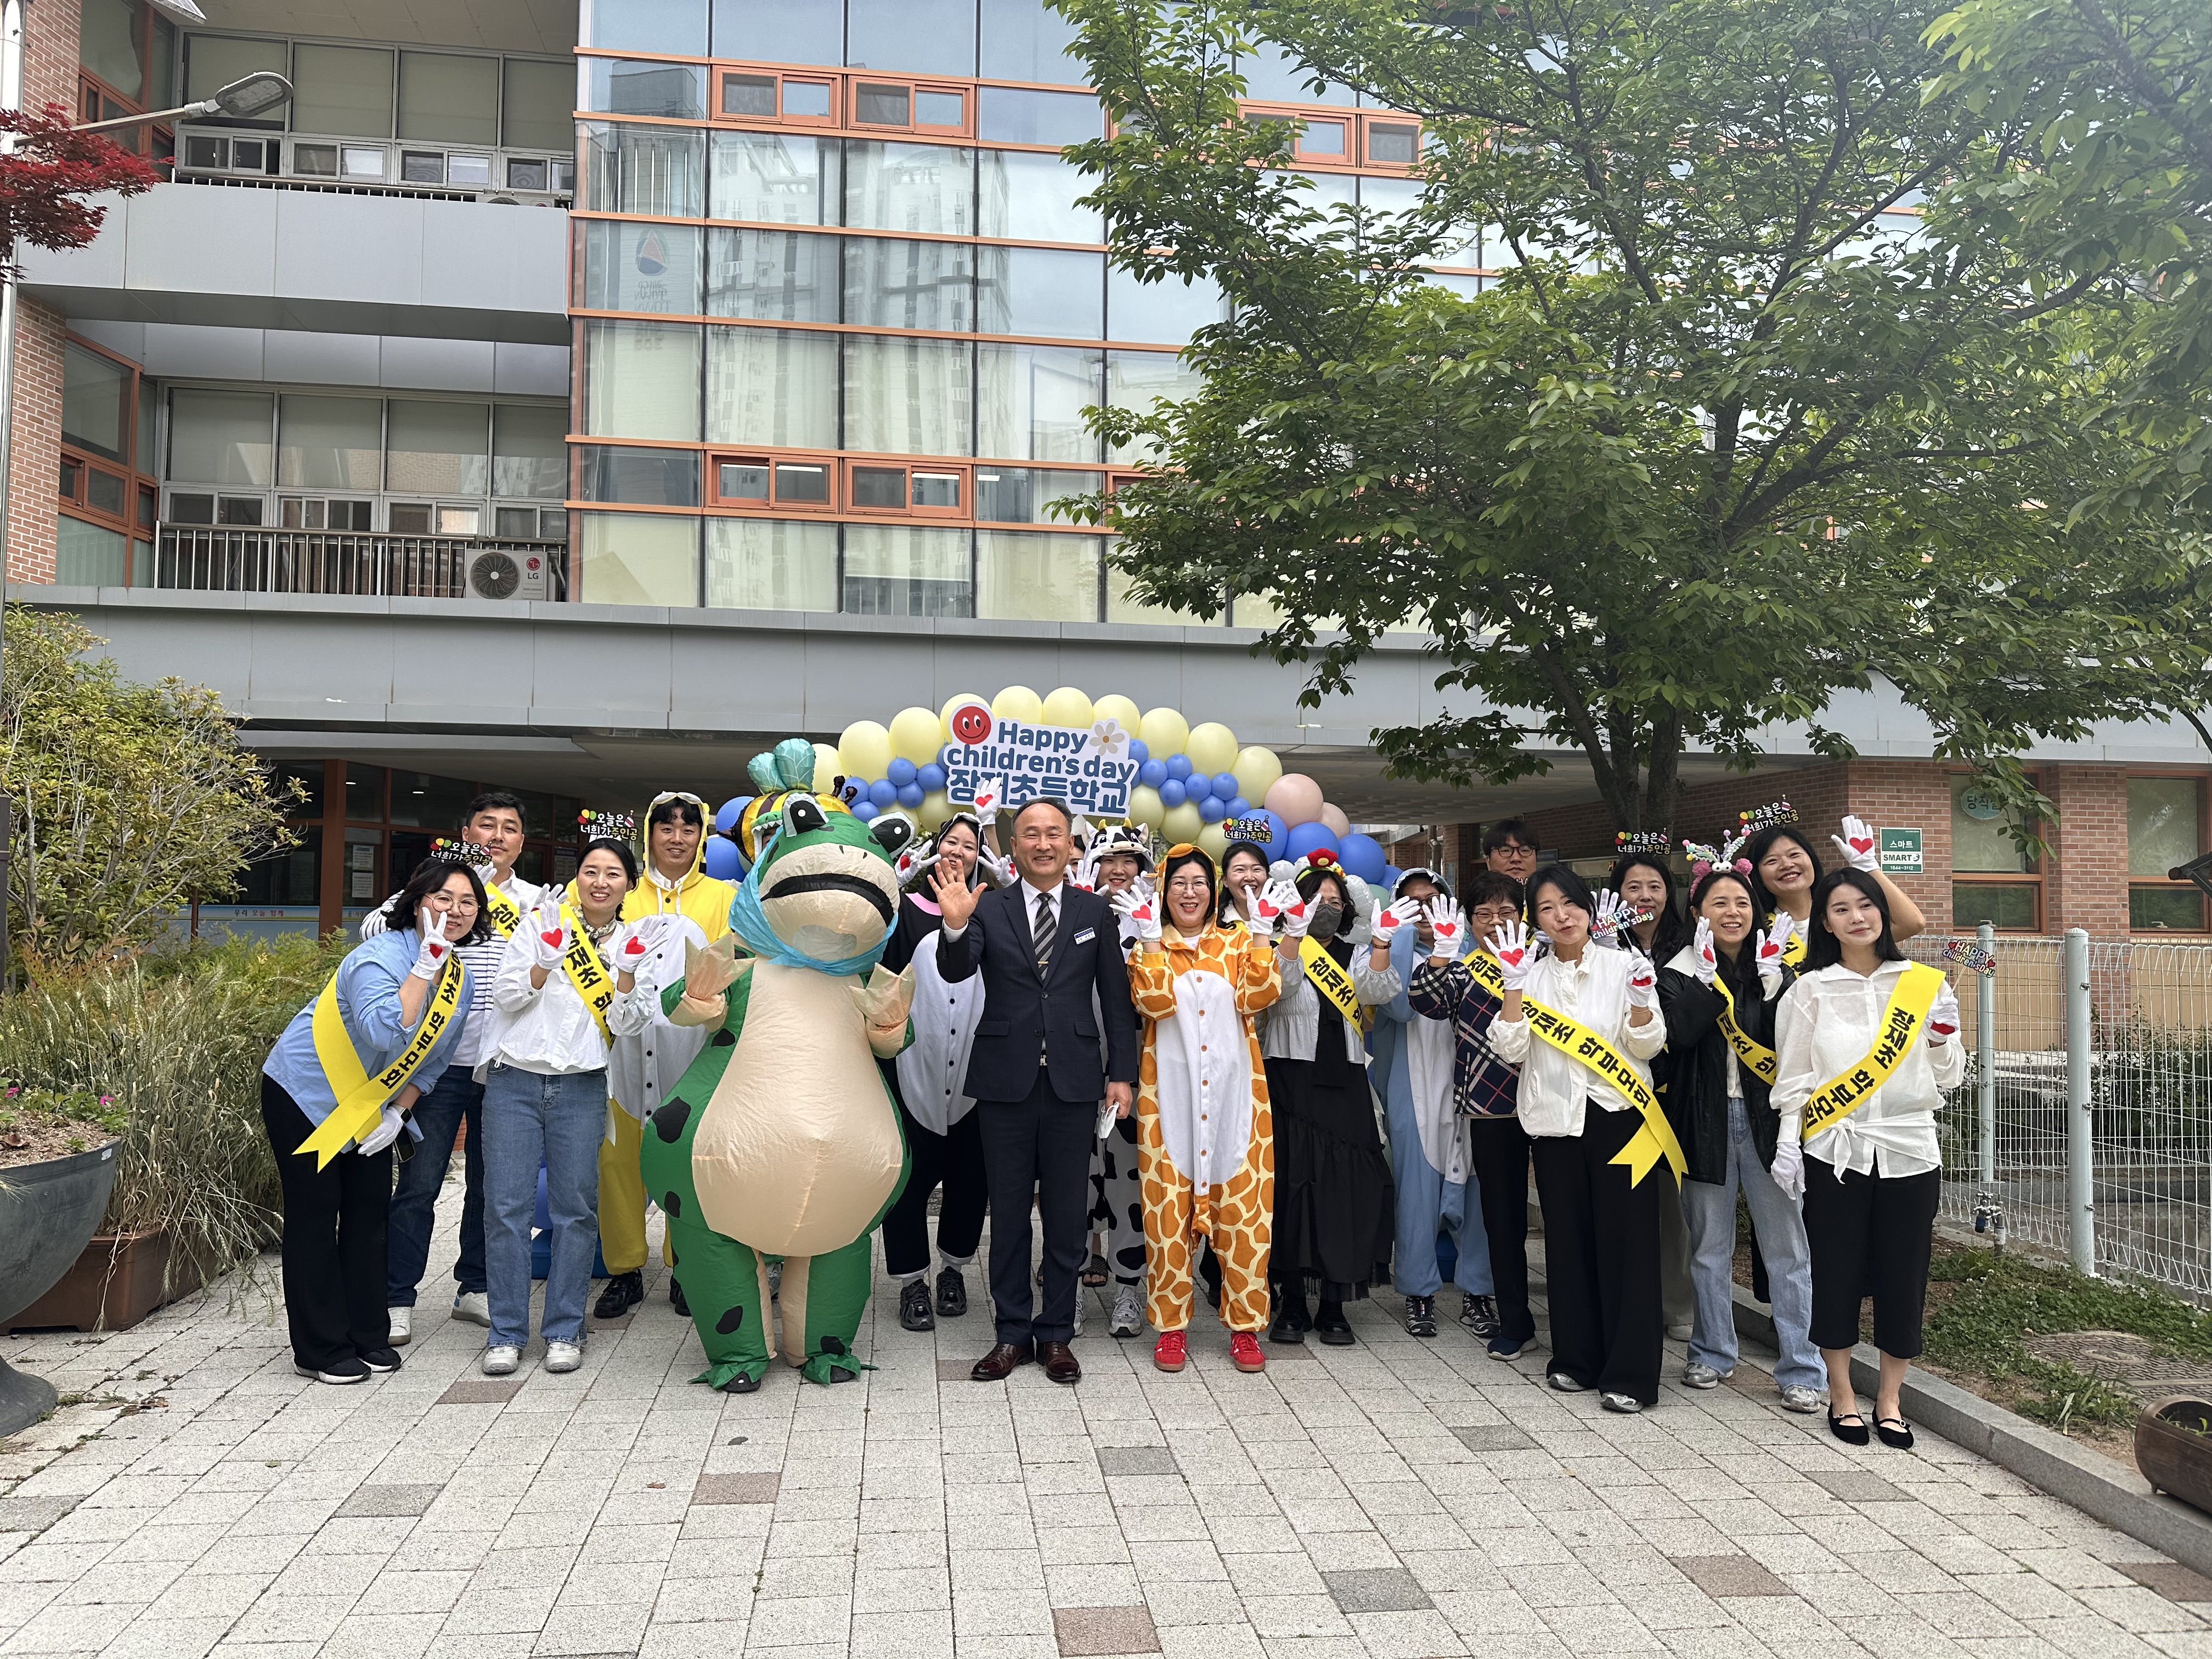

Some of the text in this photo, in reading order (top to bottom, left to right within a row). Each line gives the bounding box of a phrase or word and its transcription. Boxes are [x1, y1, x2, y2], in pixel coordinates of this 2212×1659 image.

[998, 722, 1088, 754] Happy
[1084, 755, 1135, 783] day
[596, 811, 624, 827] 오늘은
[1755, 802, 1782, 820] 오늘은
[1238, 819, 1261, 832] 오늘은
[1632, 831, 1658, 844] 오늘은
[449, 841, 480, 855] 오늘은
[1889, 840, 1914, 849] 스마트
[1596, 905, 1638, 929] HAPPY
[1954, 940, 1994, 964] HAPPY
[1308, 956, 1356, 1007] 장재초
[1467, 955, 1505, 994] 장재
[380, 1011, 445, 1090] 학부모회
[1578, 1037, 1651, 1109] 학부모회
[1806, 1007, 1916, 1130] 장재초 학부모회
